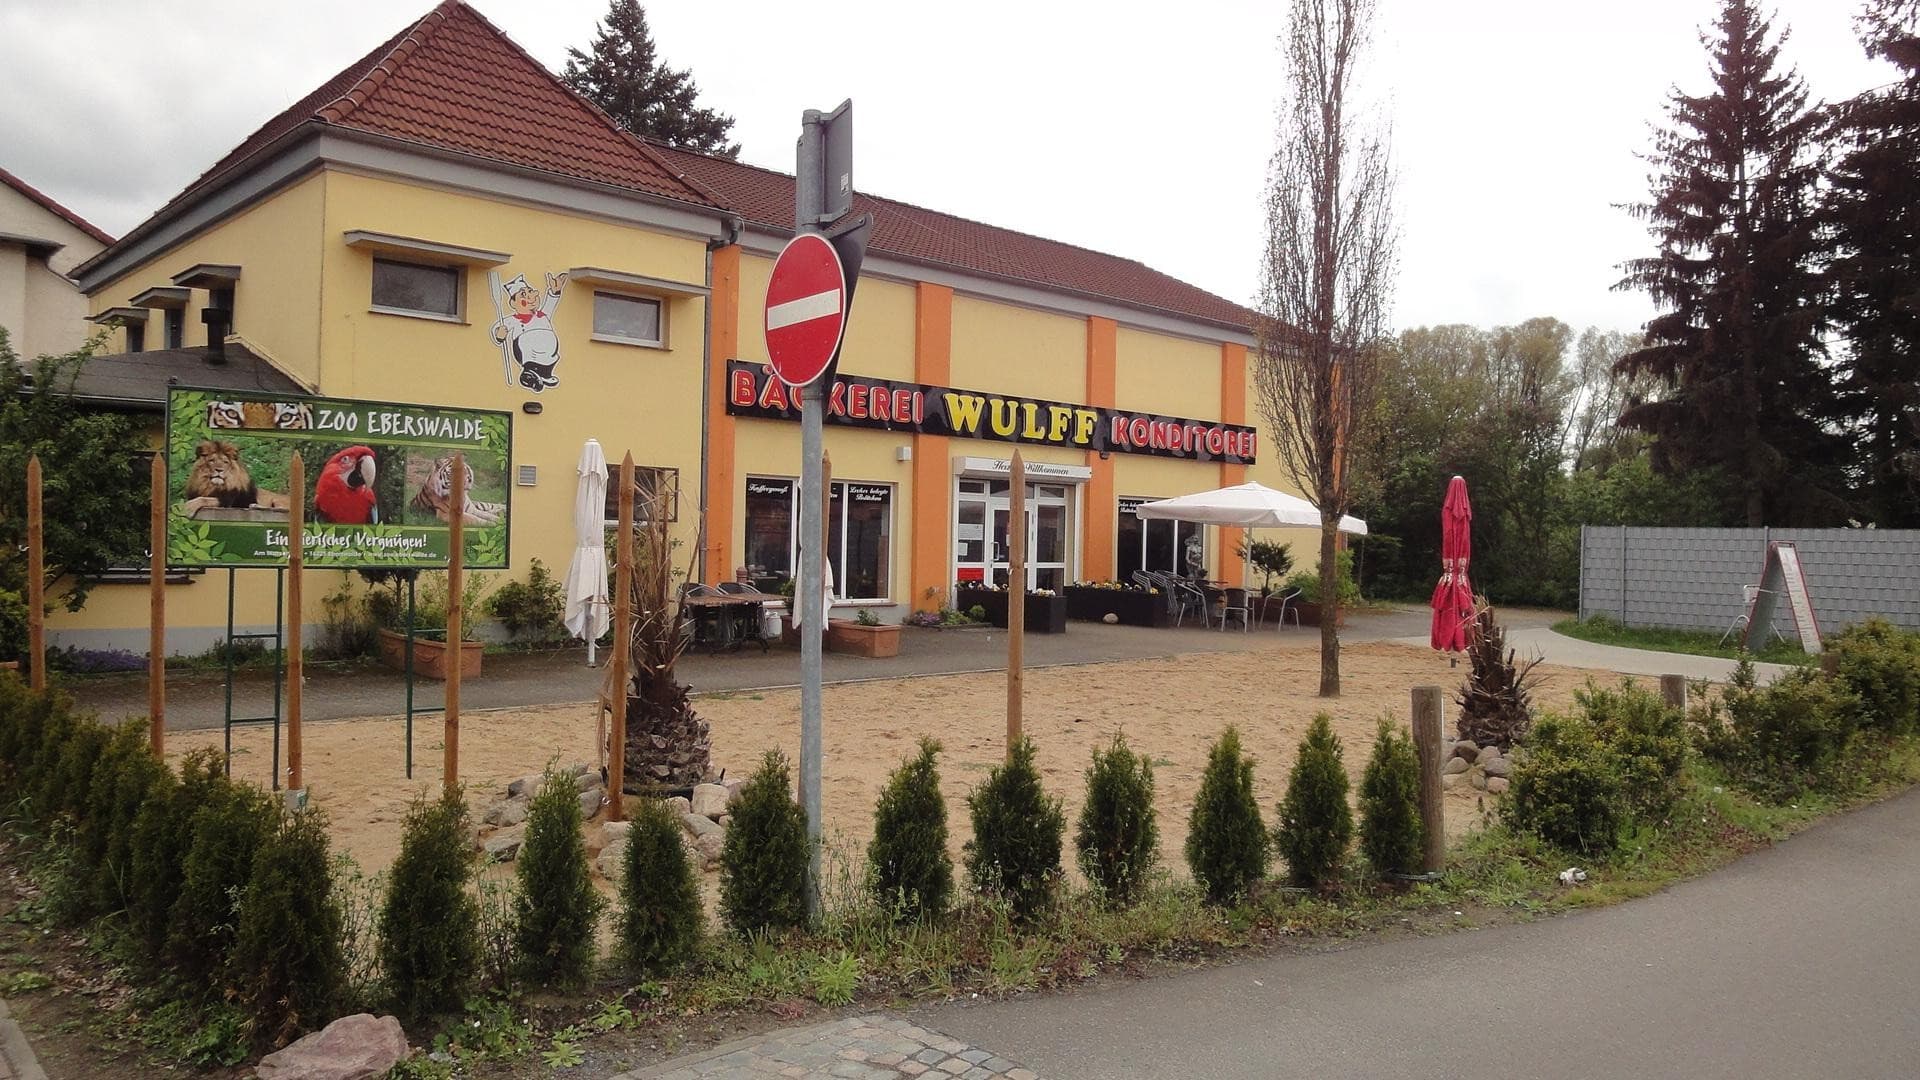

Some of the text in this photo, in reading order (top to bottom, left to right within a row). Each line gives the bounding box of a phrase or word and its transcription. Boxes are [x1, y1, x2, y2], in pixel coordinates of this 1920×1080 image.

[317, 410, 486, 440] ZOO EBERSWALDE
[944, 393, 1098, 444] WULFF
[1111, 416, 1257, 458] KONDITOREI
[266, 530, 427, 550] Ein ierisches Vergnügen!
